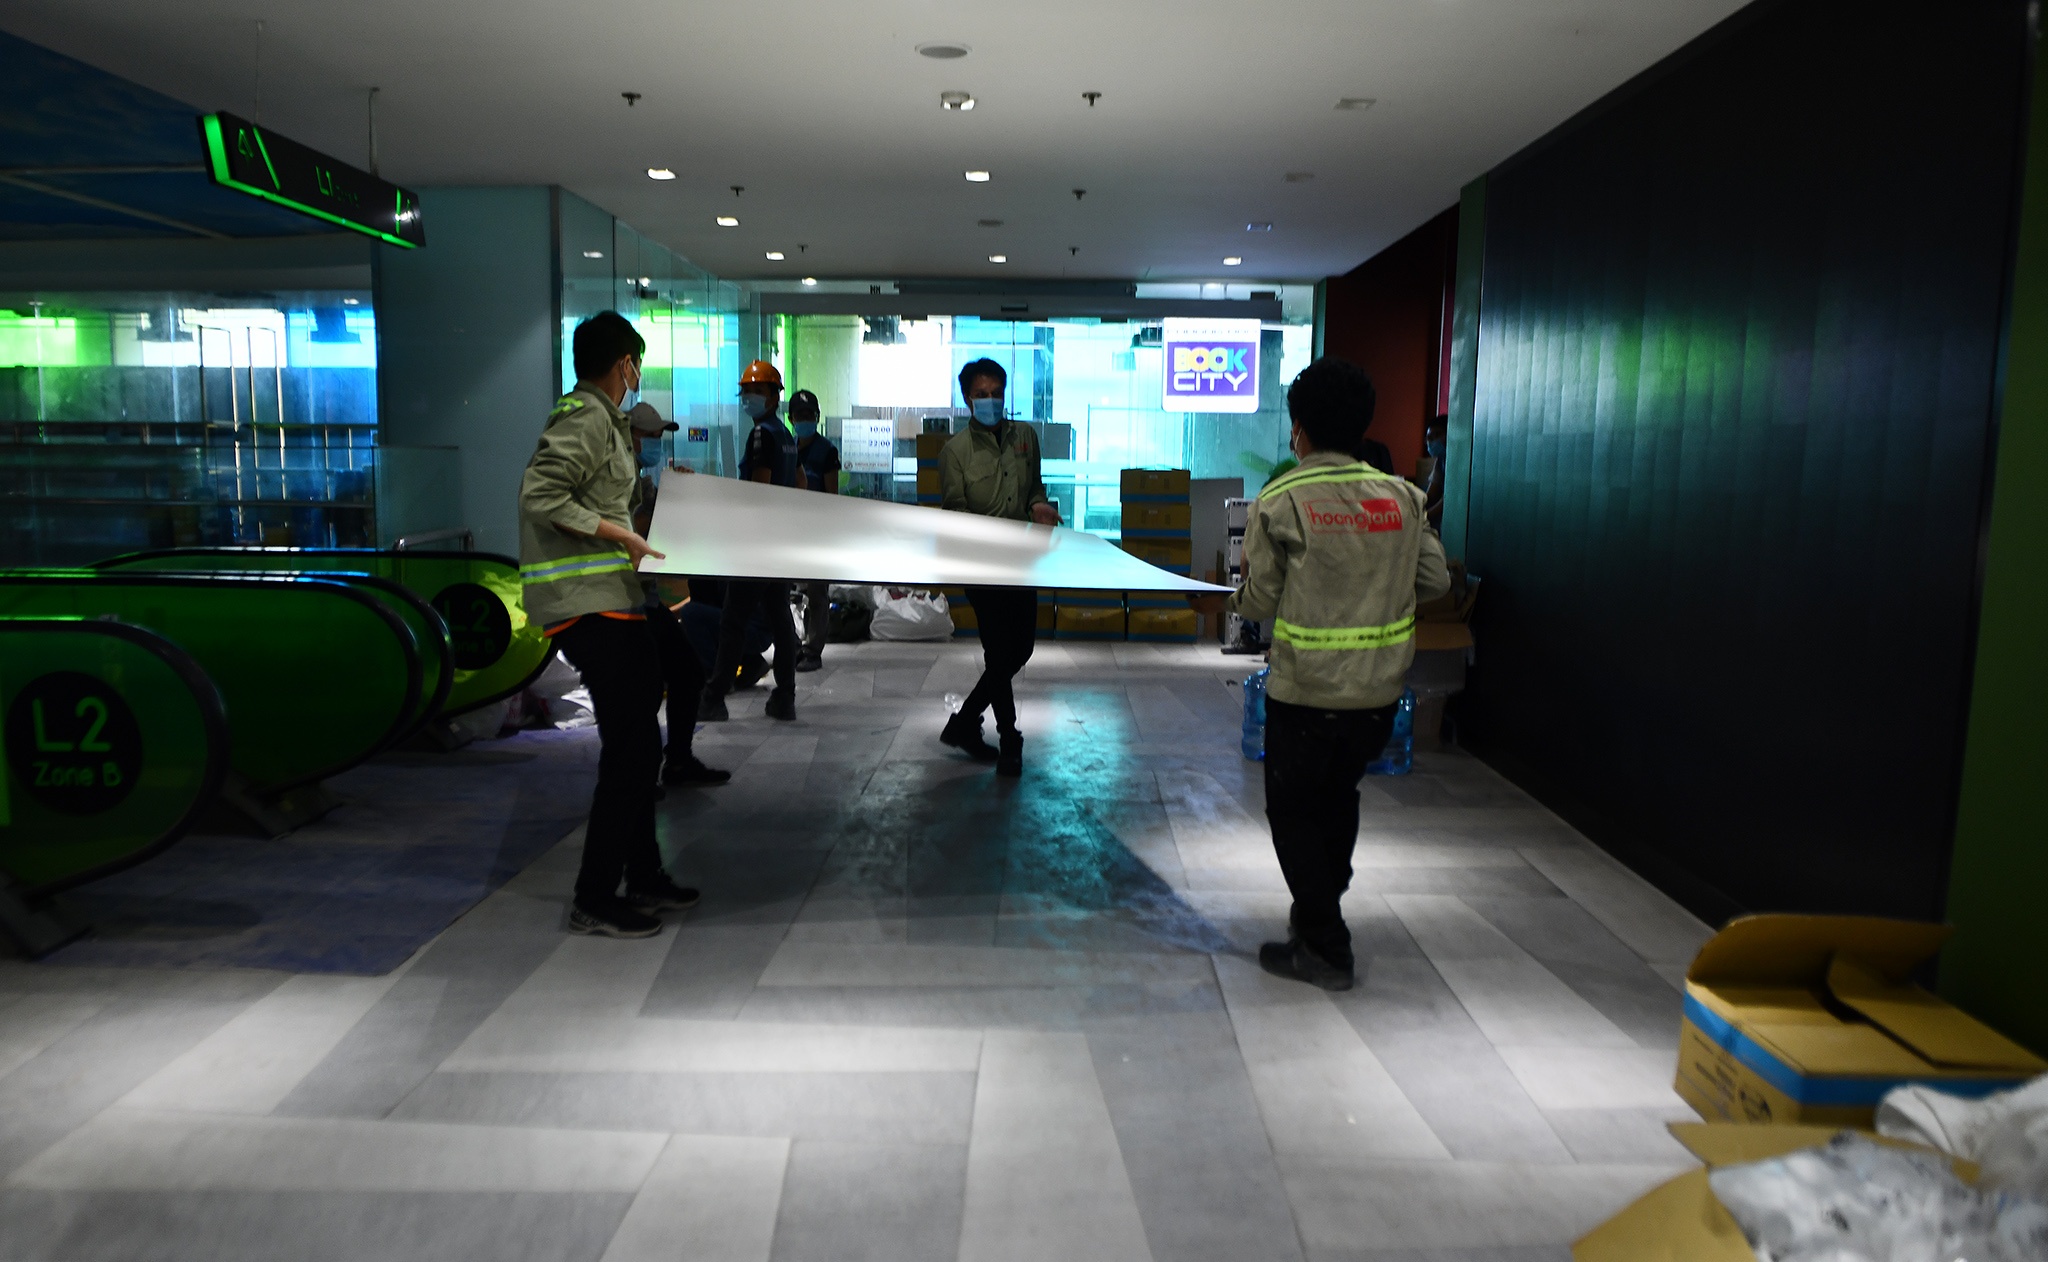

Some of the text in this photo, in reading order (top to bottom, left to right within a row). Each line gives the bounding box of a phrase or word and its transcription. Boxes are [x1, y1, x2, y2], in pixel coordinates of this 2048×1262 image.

[1173, 346, 1249, 372] BOOK
[1173, 372, 1249, 392] CITY
[1308, 504, 1401, 530] hoanglam
[442, 597, 492, 634] L2
[31, 694, 113, 753] L2
[31, 759, 124, 788] Zone B
